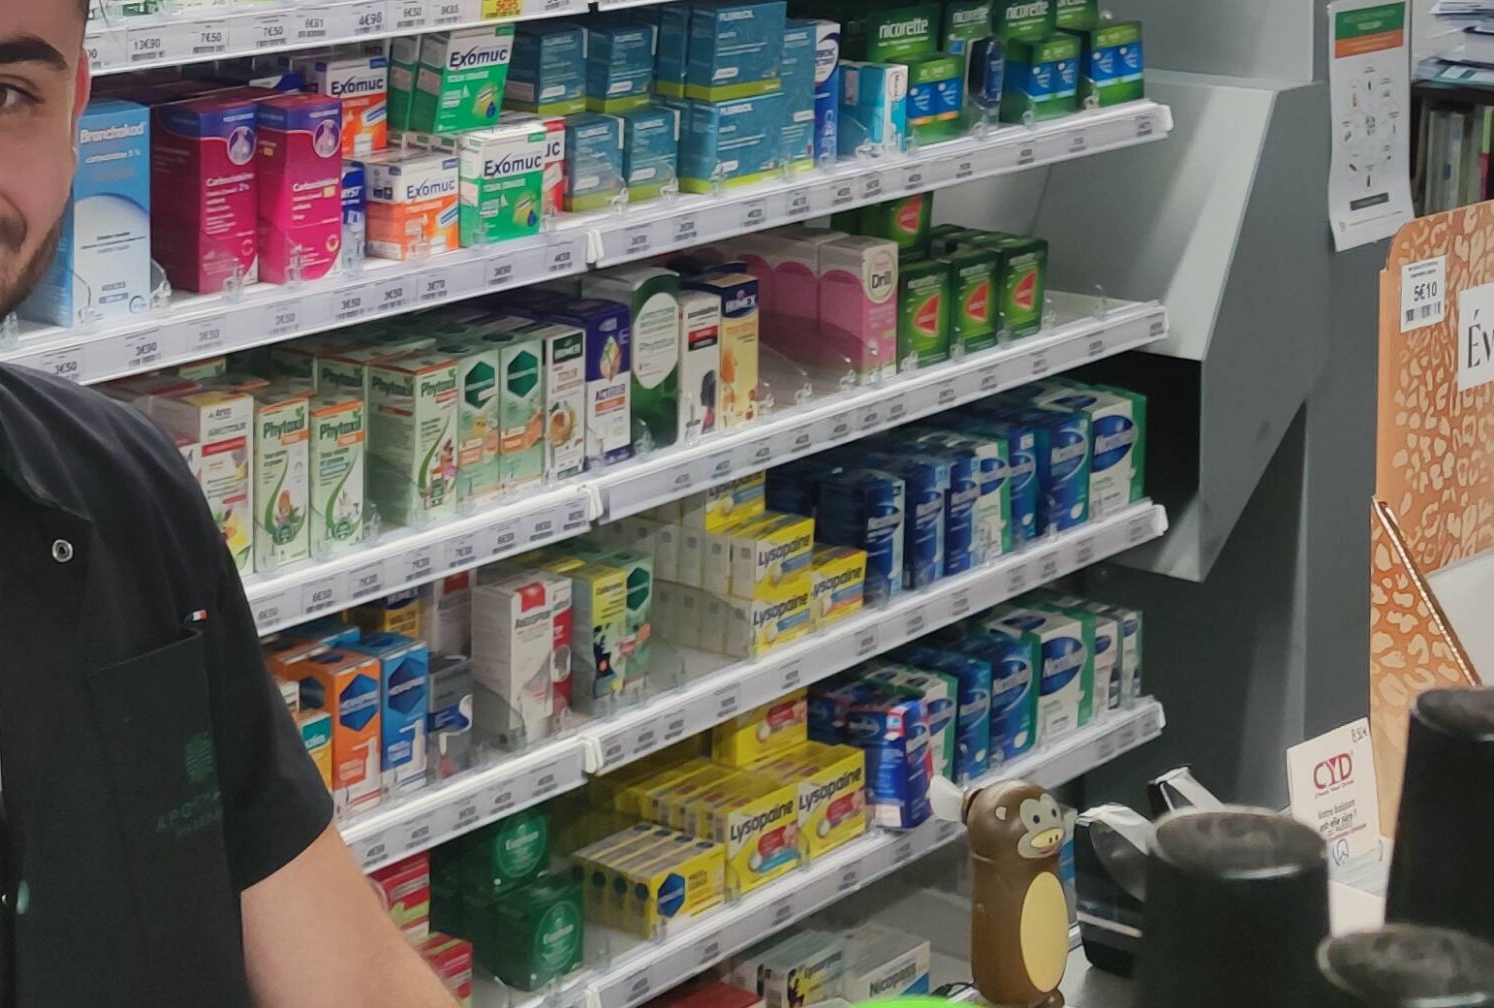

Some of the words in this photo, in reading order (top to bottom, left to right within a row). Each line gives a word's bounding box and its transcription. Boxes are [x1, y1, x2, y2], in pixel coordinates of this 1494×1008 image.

[952, 6, 989, 23] nicorette
[1006, 0, 1049, 20] nicorette
[200, 31, 222, 43] 7€50
[263, 25, 284, 38] 7€50
[879, 17, 929, 39] nicorette
[449, 45, 508, 69] Exomuc
[331, 76, 384, 97] Exomuc
[483, 152, 543, 178] Exomuc
[406, 178, 456, 200] Exomuc
[871, 269, 892, 290] Drill
[1413, 281, 1438, 303] 5€10
[758, 534, 811, 571] Lysopaine
[753, 592, 809, 628] Lysopaine
[1313, 752, 1353, 790] CYD
[798, 766, 862, 812] Lysopaine
[730, 799, 794, 842] Lysopaine
